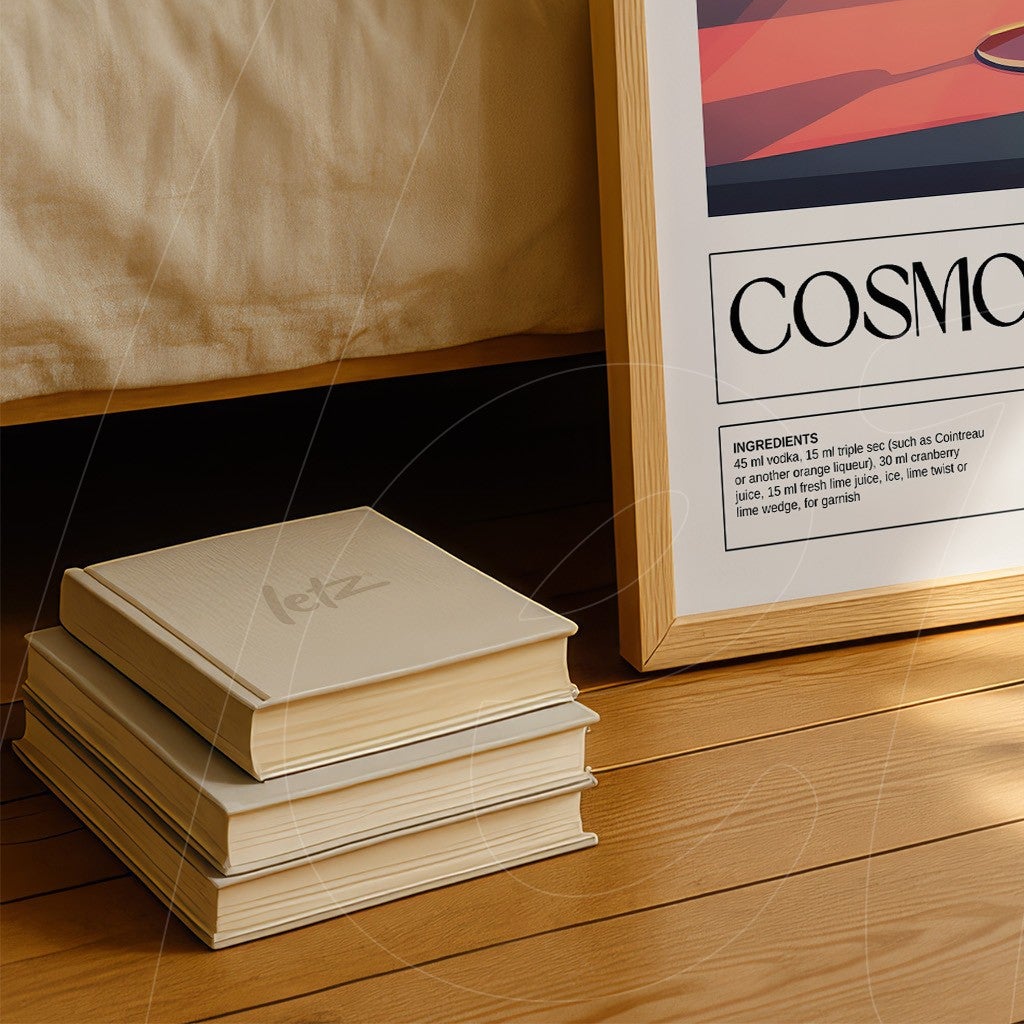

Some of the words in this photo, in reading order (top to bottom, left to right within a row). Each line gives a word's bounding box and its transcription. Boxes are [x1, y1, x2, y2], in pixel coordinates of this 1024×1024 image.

[733, 432, 818, 453] INGREDIENTS
[733, 457, 747, 469] 45
[750, 455, 764, 467] ml
[766, 452, 802, 465] vodka,
[805, 448, 819, 460] 15
[822, 446, 834, 458] ml
[837, 443, 863, 458] triple
[866, 442, 885, 452] sec
[887, 436, 916, 452] (such
[919, 436, 932, 445] as
[934, 429, 984, 443] Cointreau
[734, 476, 746, 485] or
[748, 469, 790, 484] another
[792, 465, 830, 478] orange
[833, 457, 876, 474] liqueur),
[879, 455, 892, 466] 30
[895, 452, 907, 464] ml
[910, 448, 960, 462] cranberry
[735, 489, 764, 504] juice,
[767, 485, 781, 497] 15
[784, 483, 797, 495] ml
[799, 479, 826, 493] fresh
[829, 478, 851, 489] lime
[854, 473, 882, 488] juice,
[885, 471, 903, 481] ice,
[906, 468, 928, 478] lime
[930, 463, 954, 475] twist
[956, 463, 967, 472] or
[736, 506, 758, 517] lime
[761, 500, 801, 514] wedge,
[804, 497, 818, 508] for
[821, 491, 860, 508] garnish
[262, 576, 391, 625] letz
